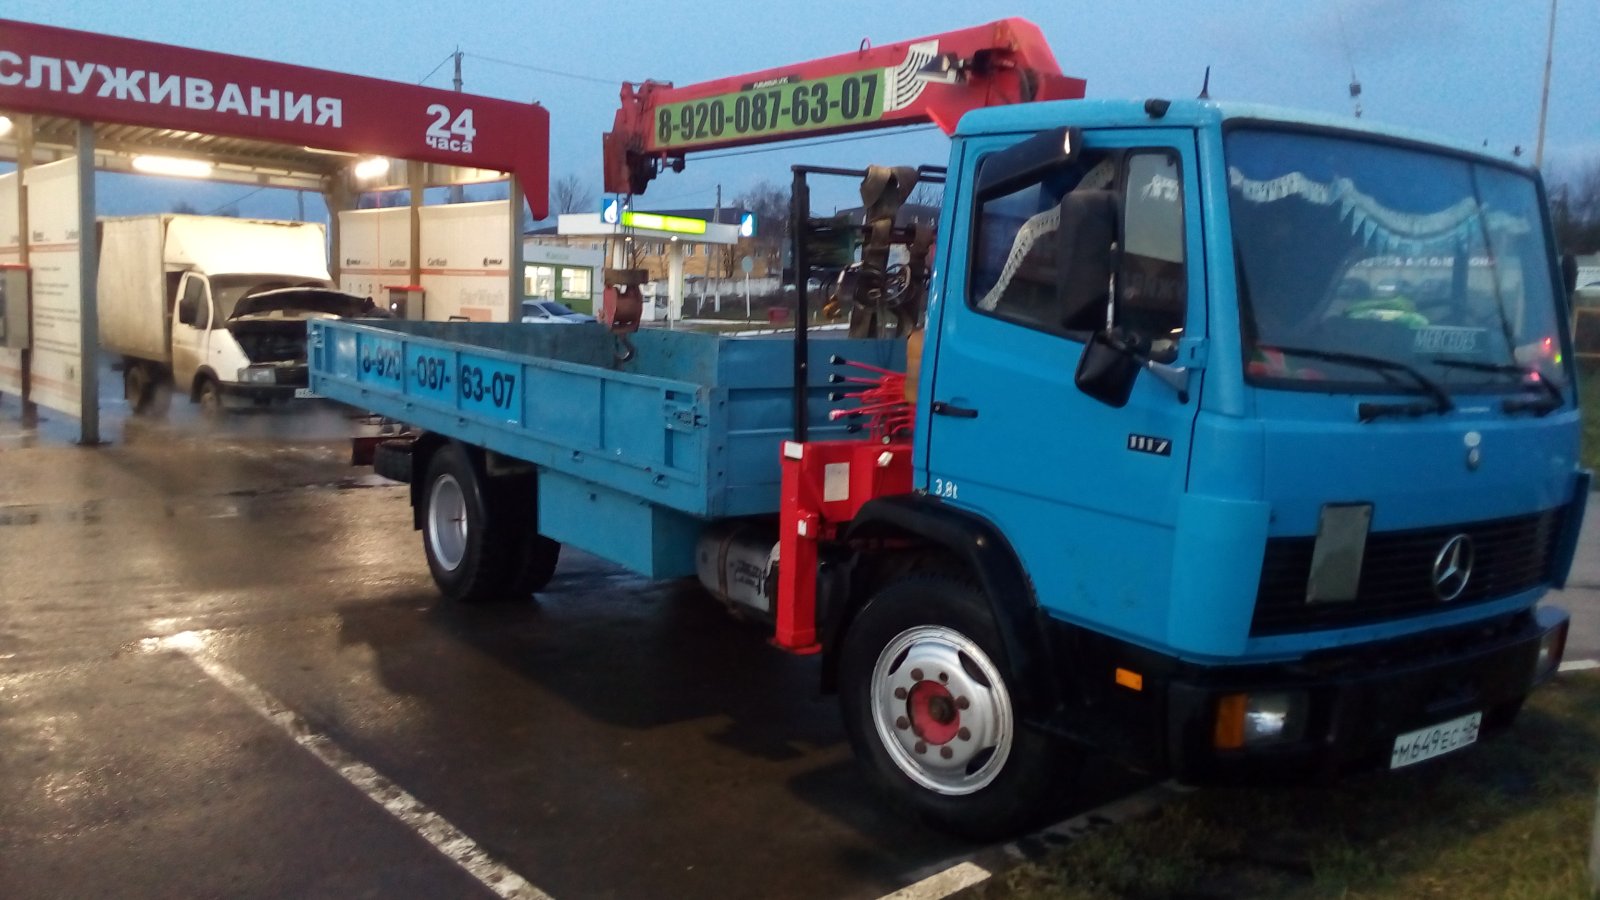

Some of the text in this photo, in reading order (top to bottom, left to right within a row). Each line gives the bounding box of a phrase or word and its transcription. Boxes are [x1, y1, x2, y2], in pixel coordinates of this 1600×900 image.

[0, 50, 342, 128] СЛУЖИВАНИЯ
[658, 73, 878, 144] 8-920-087-63-07
[426, 104, 477, 142] 24
[426, 136, 473, 153] часа
[461, 364, 515, 410] 63-07
[1130, 435, 1169, 454] 1117
